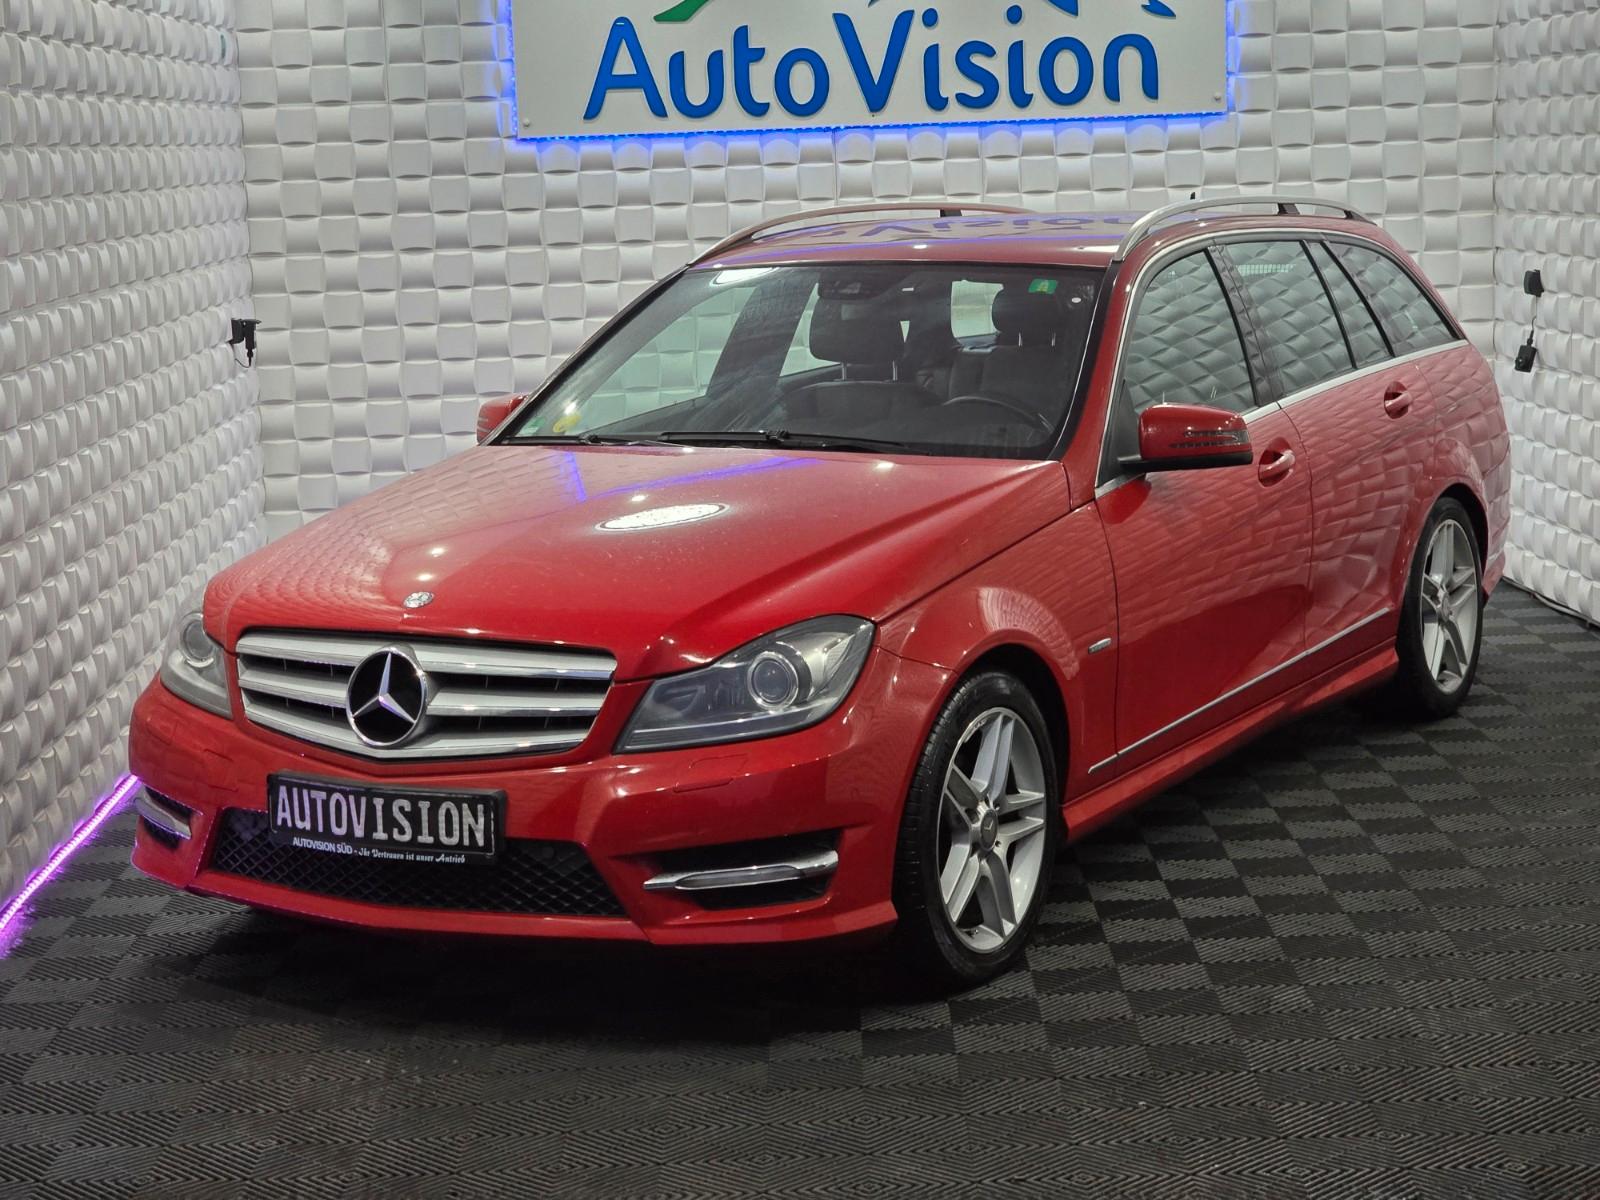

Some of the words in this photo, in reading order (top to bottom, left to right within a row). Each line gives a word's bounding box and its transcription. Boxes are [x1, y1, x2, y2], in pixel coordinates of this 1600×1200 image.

[583, 5, 1159, 120] AutoVision
[276, 785, 485, 847] AUTOVISION
[292, 836, 336, 853] AUTOVISION
[336, 841, 353, 855] SÜD
[371, 848, 405, 861] Vertrauen
[405, 851, 415, 861] ist
[415, 854, 435, 863] unser
[435, 853, 466, 864] Antrieb
